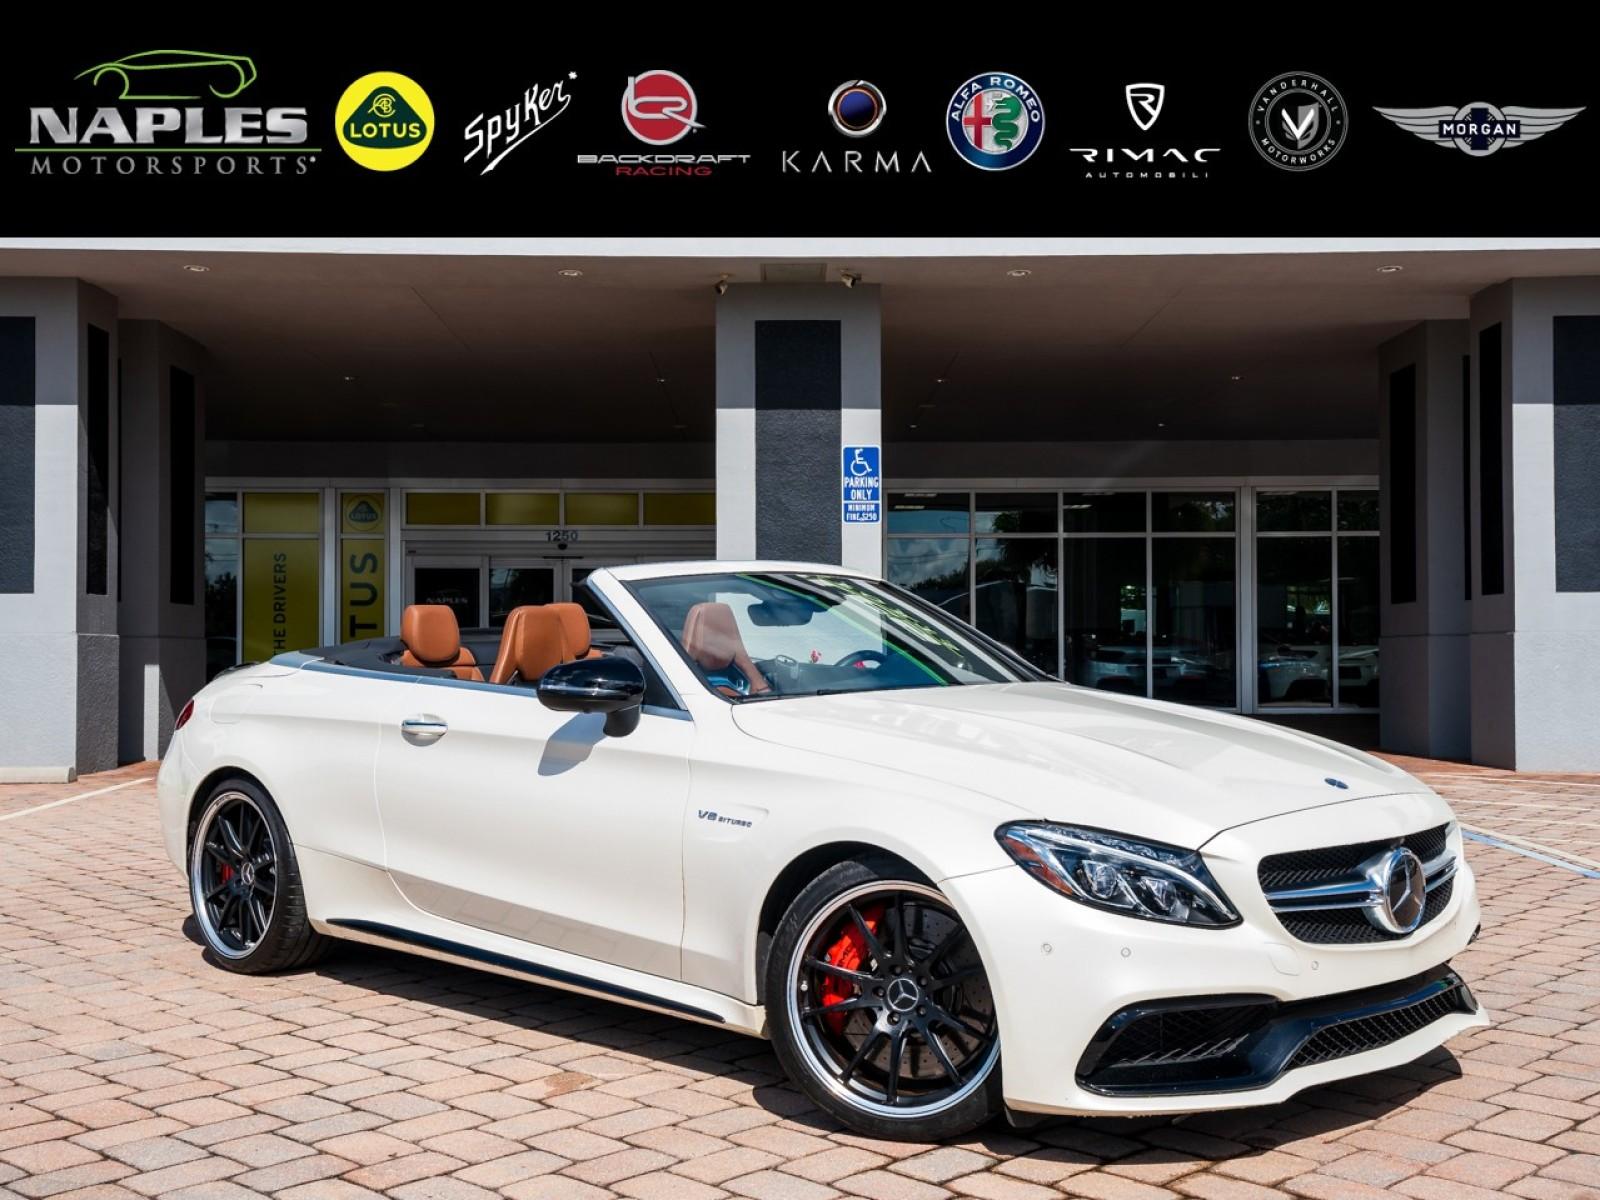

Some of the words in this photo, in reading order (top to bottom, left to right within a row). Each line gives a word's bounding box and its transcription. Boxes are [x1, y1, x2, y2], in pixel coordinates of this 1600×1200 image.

[844, 476, 879, 488] PARKING
[850, 489, 873, 500] ONLY
[847, 504, 875, 512] MINIMUM
[544, 530, 579, 542] 1250
[273, 552, 287, 624] DRIVERS
[698, 810, 718, 821] V8
[718, 816, 753, 828] BITURBO
